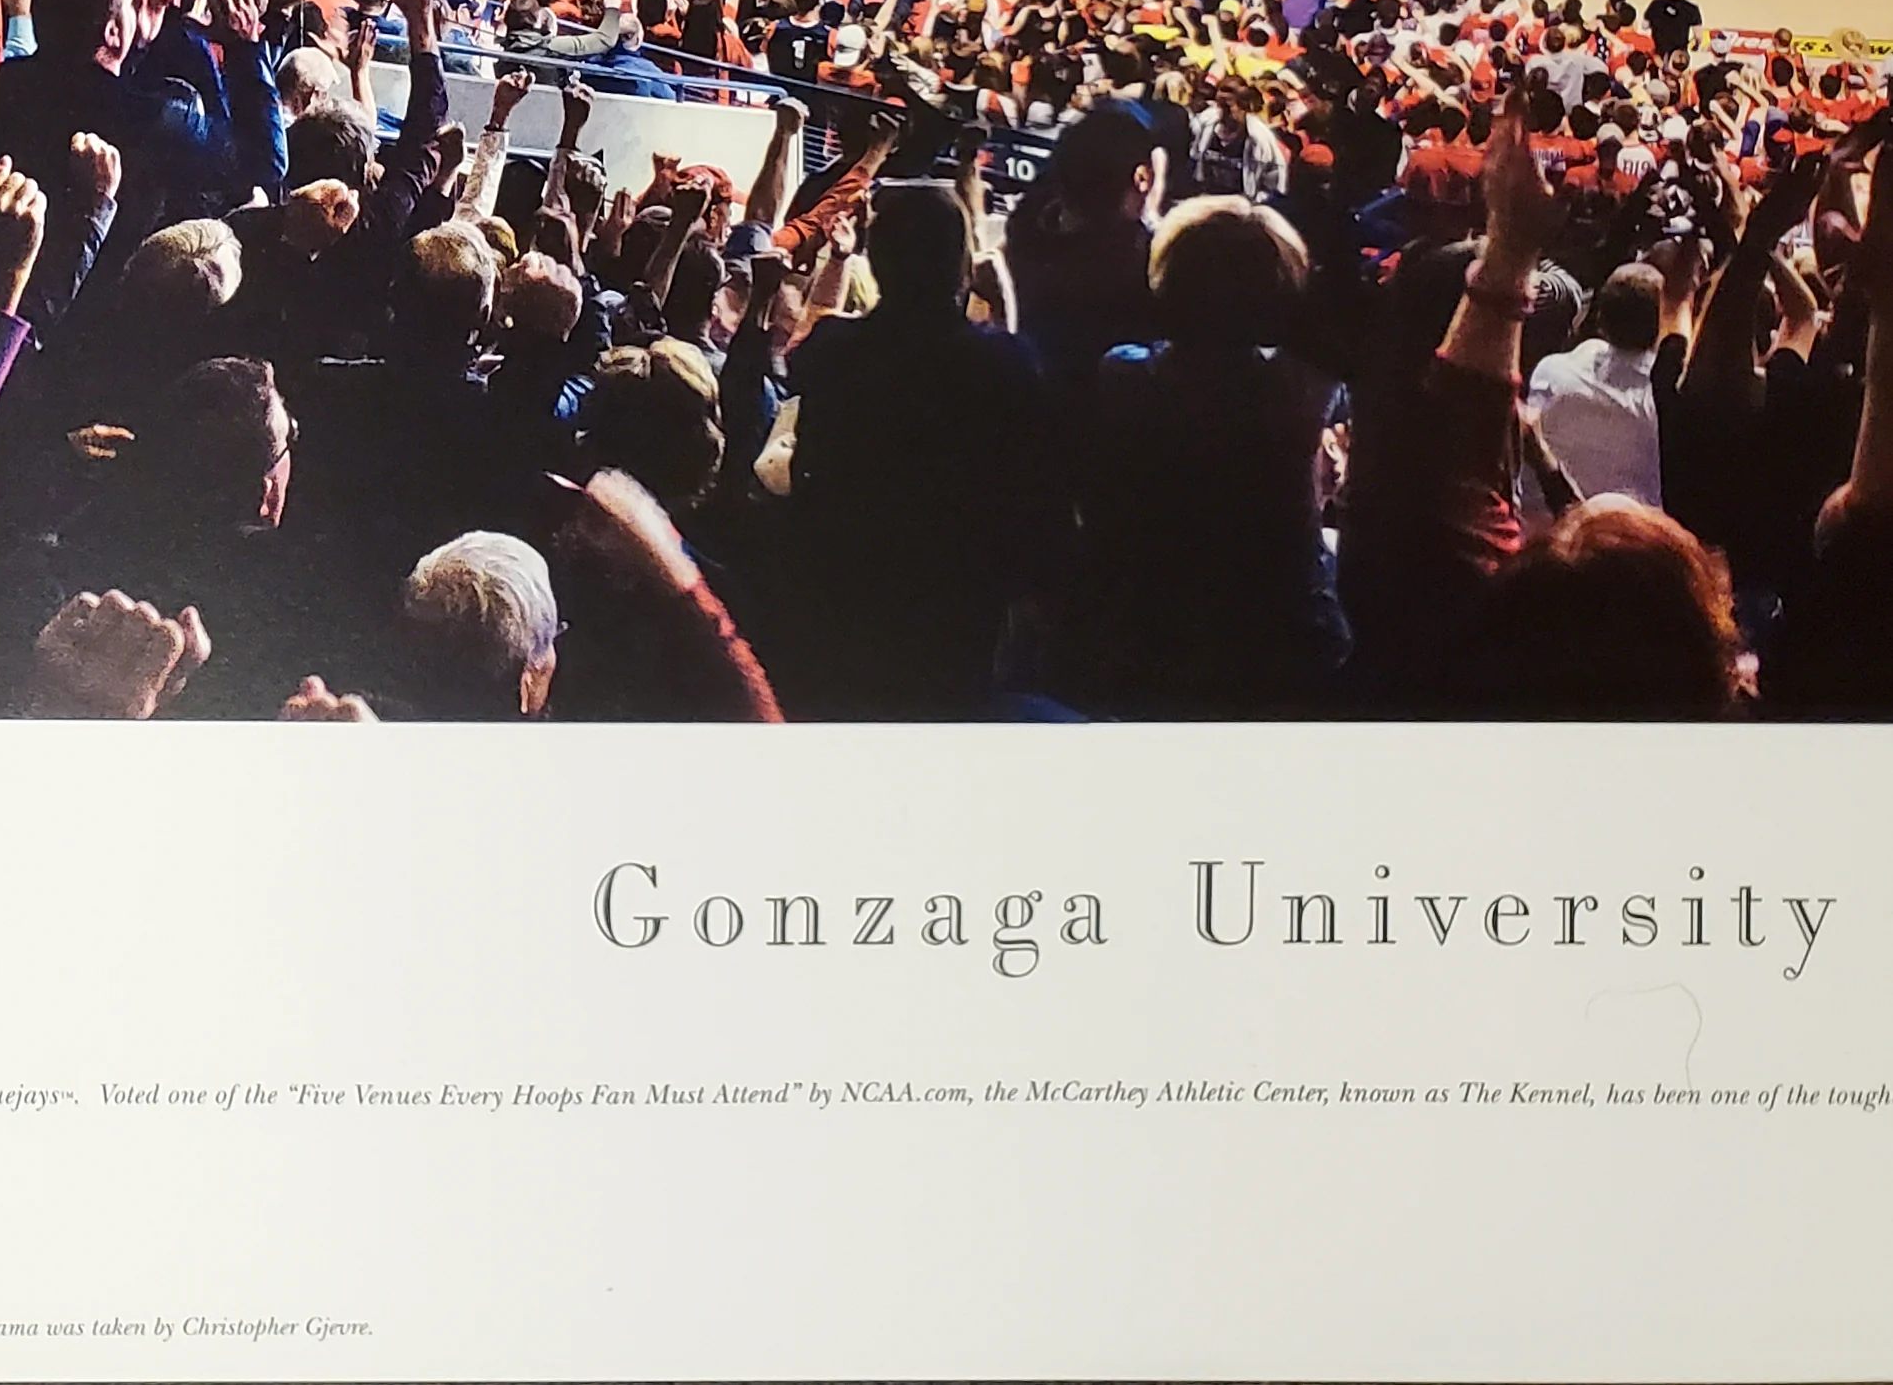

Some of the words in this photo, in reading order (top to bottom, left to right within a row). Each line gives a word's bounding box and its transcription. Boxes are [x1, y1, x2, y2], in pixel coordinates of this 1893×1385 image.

[1005, 157, 1036, 182] 10
[593, 861, 1110, 979] Gonzaga
[1187, 860, 1838, 982] University
[101, 1082, 160, 1105] Voted
[168, 1090, 208, 1105] one
[214, 1083, 241, 1112] of
[244, 1083, 278, 1105] the
[356, 1083, 432, 1106] Venues
[439, 1084, 504, 1113] Every
[511, 1084, 583, 1113] Hoops
[591, 1084, 636, 1105] Fan
[644, 1083, 705, 1105] Must
[808, 1082, 833, 1110] by
[840, 1081, 974, 1106] NCAA.com,
[984, 1080, 1019, 1102] the
[1025, 1080, 1149, 1109] McCarthey
[1155, 1080, 1246, 1102] Athletic
[1253, 1080, 1329, 1107] Center,
[1339, 1081, 1416, 1103] known
[1424, 1088, 1450, 1103] as
[1458, 1081, 1502, 1104] The
[1508, 1082, 1595, 1108] Kennel,
[1605, 1082, 1646, 1105] has
[1653, 1082, 1701, 1105] been
[1710, 1089, 1751, 1105] one
[1757, 1084, 1783, 1113] of
[1786, 1083, 1821, 1106] the
[46, 1323, 85, 1337] was
[92, 1317, 146, 1336] taken
[153, 1316, 175, 1342] by
[182, 1316, 300, 1342] Christopher
[305, 1317, 373, 1342] Gjevre.
